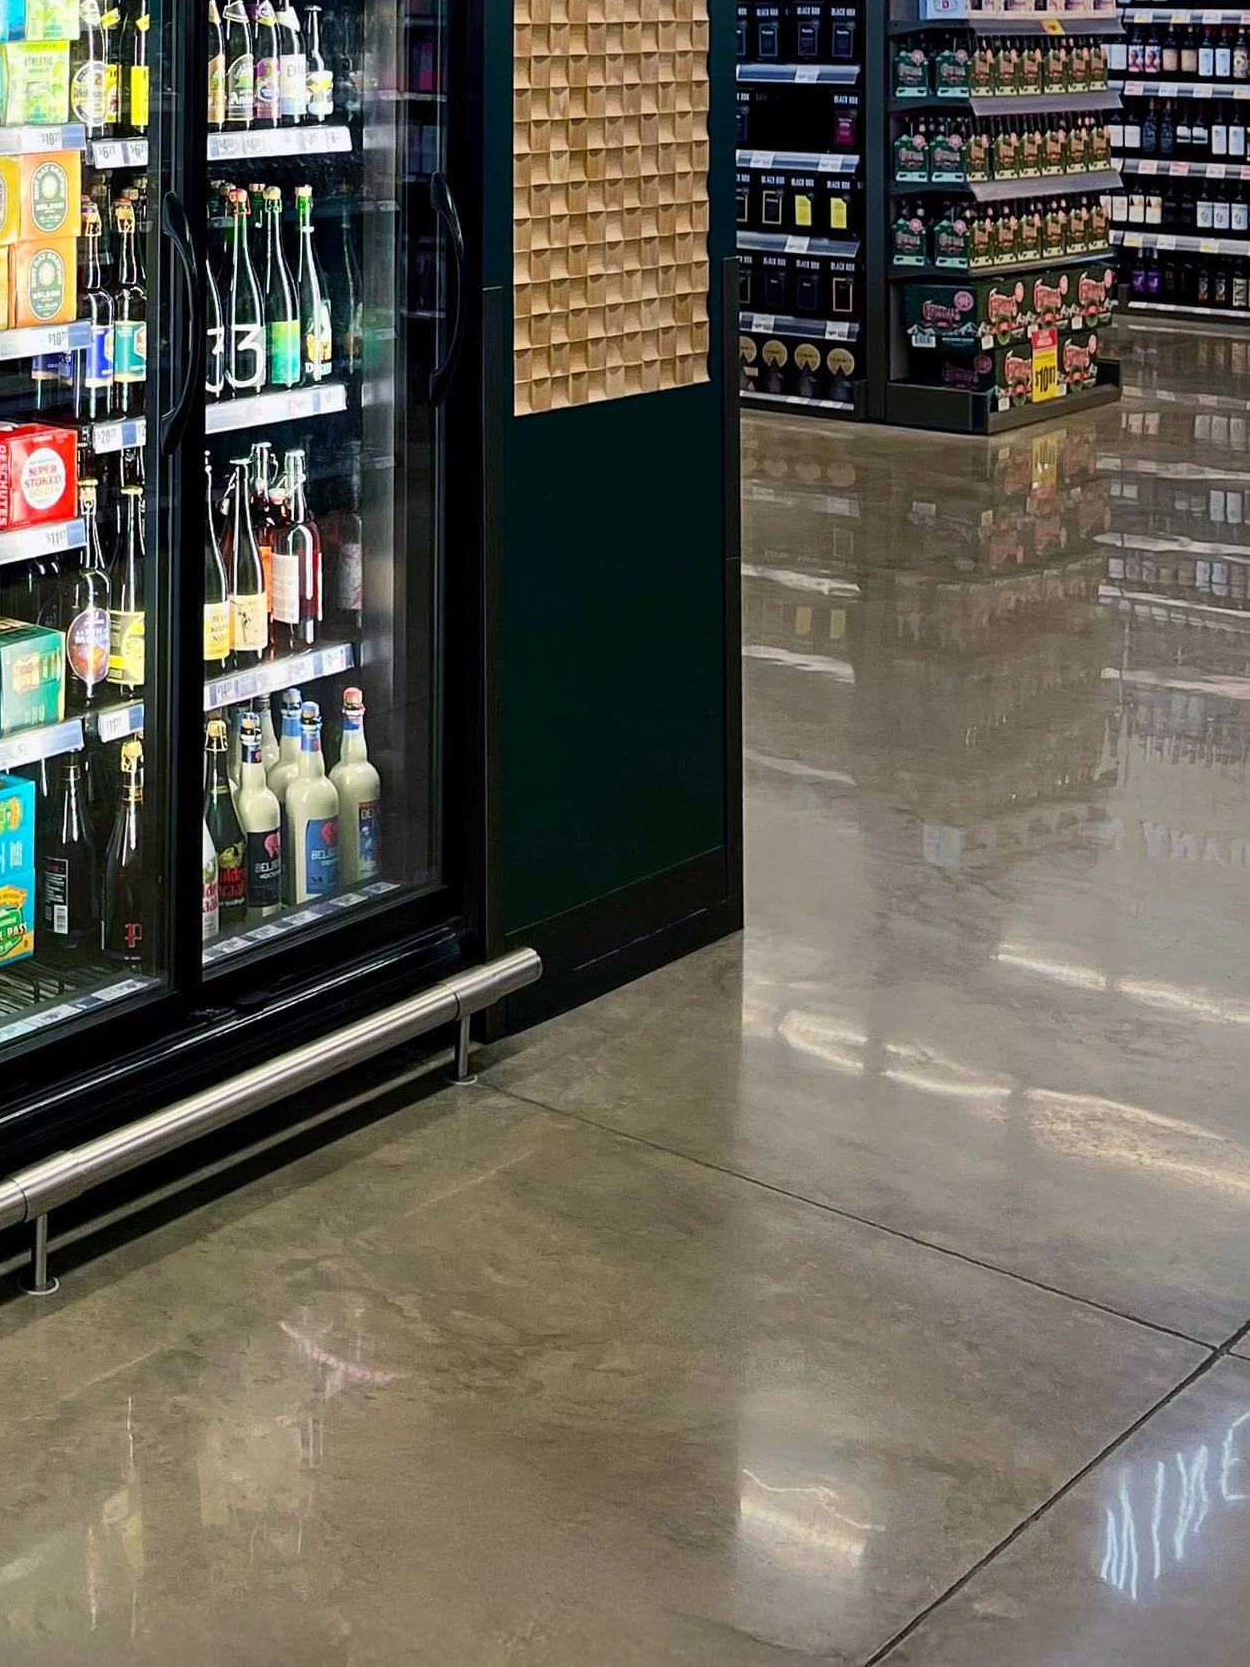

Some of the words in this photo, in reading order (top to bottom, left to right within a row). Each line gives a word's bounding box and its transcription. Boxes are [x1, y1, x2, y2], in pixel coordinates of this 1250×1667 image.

[28, 464, 58, 476] SUPER
[24, 474, 62, 489] STOKED
[7, 923, 28, 939] PASS
